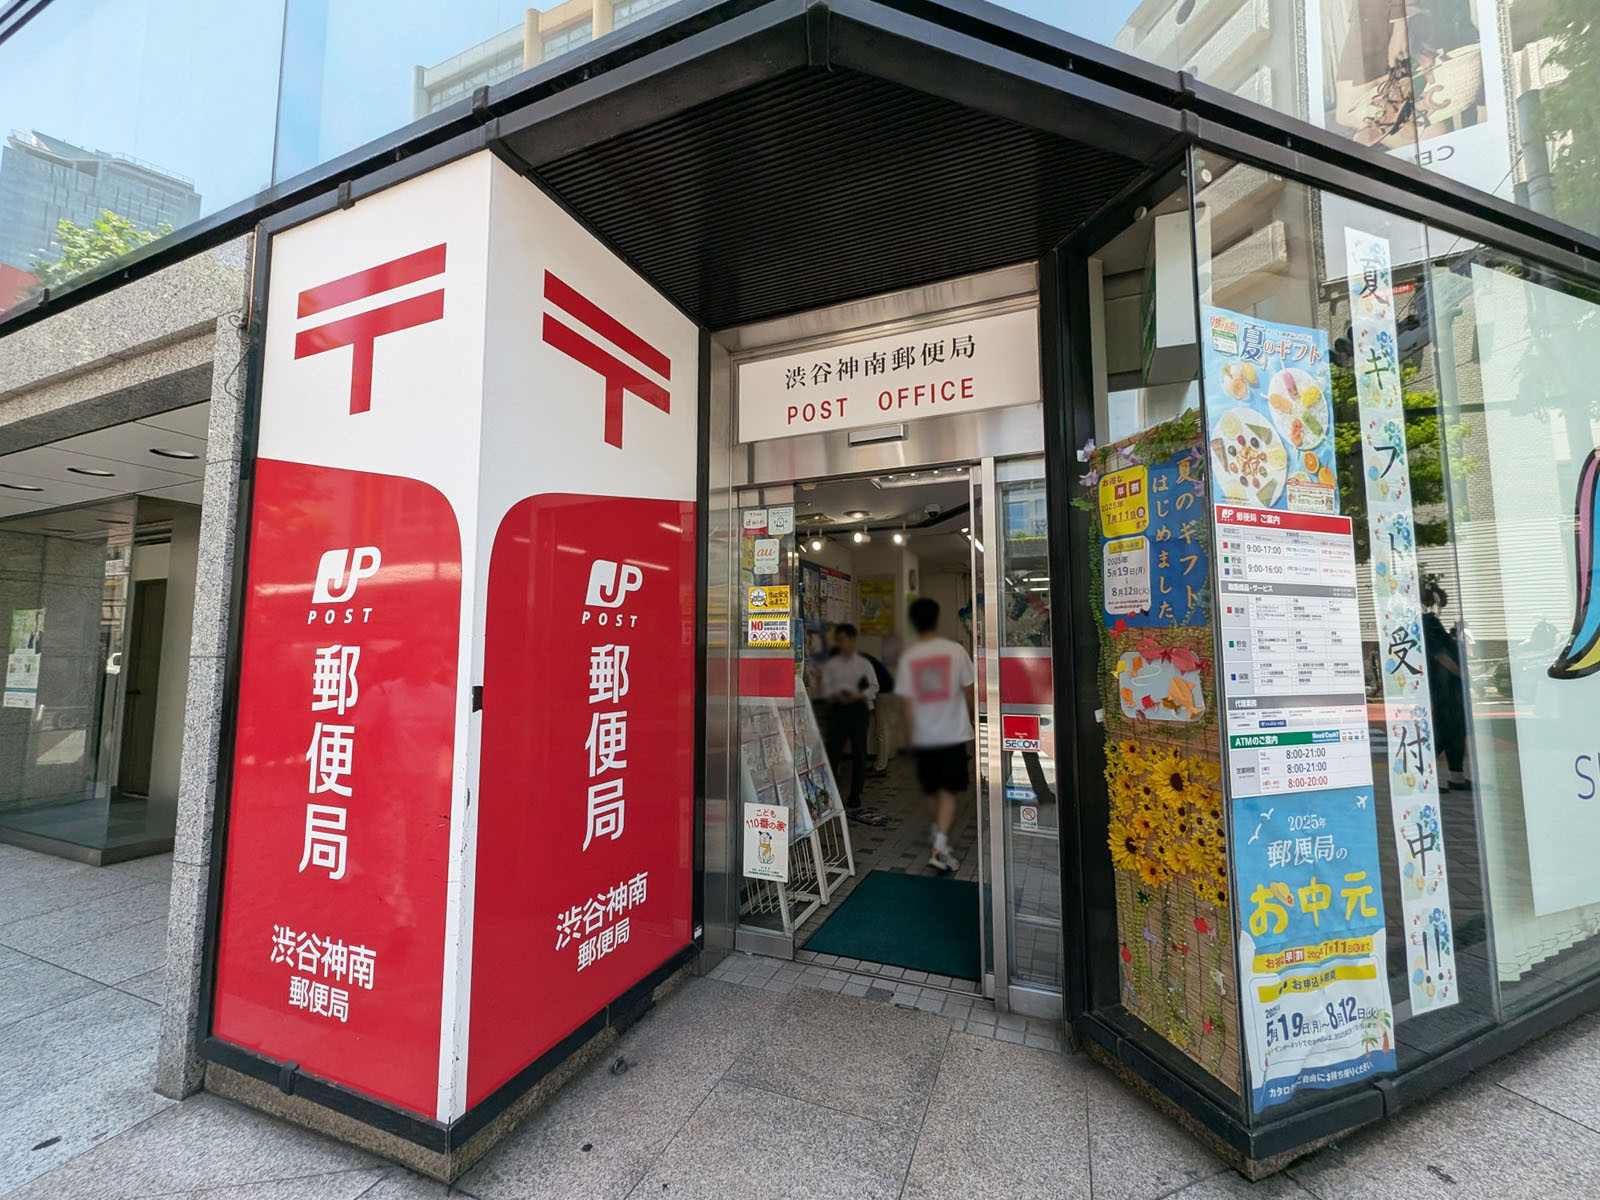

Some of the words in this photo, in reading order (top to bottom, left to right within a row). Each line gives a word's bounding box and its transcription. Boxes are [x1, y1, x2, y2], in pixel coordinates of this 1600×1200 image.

[1240, 322, 1322, 362] 夏のギフト
[785, 334, 976, 390] 渋谷神南郵便局
[787, 397, 848, 425] POST
[878, 377, 974, 411] OFFICE
[1116, 482, 1142, 498] 早割
[1101, 502, 1124, 513] 2025年
[1136, 520, 1148, 531] まで
[1236, 512, 1258, 523] 郵便局
[1260, 514, 1281, 526] ご案内
[1176, 456, 1199, 609] 夏のギフト
[757, 549, 775, 558] au
[1153, 474, 1174, 620] はじめました
[1246, 544, 1282, 555] 9:00-17:00
[1107, 556, 1128, 566] 2025年
[1248, 564, 1283, 574] 9:00-16:00
[312, 546, 382, 604] JP
[585, 559, 643, 608] JP
[307, 608, 373, 625] POST
[581, 611, 637, 628] POST
[751, 620, 763, 631] NO
[582, 643, 630, 852] 郵便局
[1005, 740, 1038, 748] SECOM
[1235, 735, 1278, 747] ATMのご案内
[1286, 747, 1326, 759] 8:00-21:00
[299, 645, 360, 881] 郵便局
[1286, 761, 1327, 774] 8:00-21:00
[1287, 775, 1328, 788] 8:00-20:00
[756, 809, 777, 818] こども
[746, 818, 787, 833] 110番の家
[1287, 814, 1327, 831] 2025年
[1267, 834, 1348, 868] 郵便局の
[555, 871, 648, 951] 渋谷神南
[1249, 871, 1378, 937] お中元
[577, 917, 630, 972] 郵便局
[270, 924, 376, 990] 渋谷神南
[289, 976, 349, 1023] 郵便局
